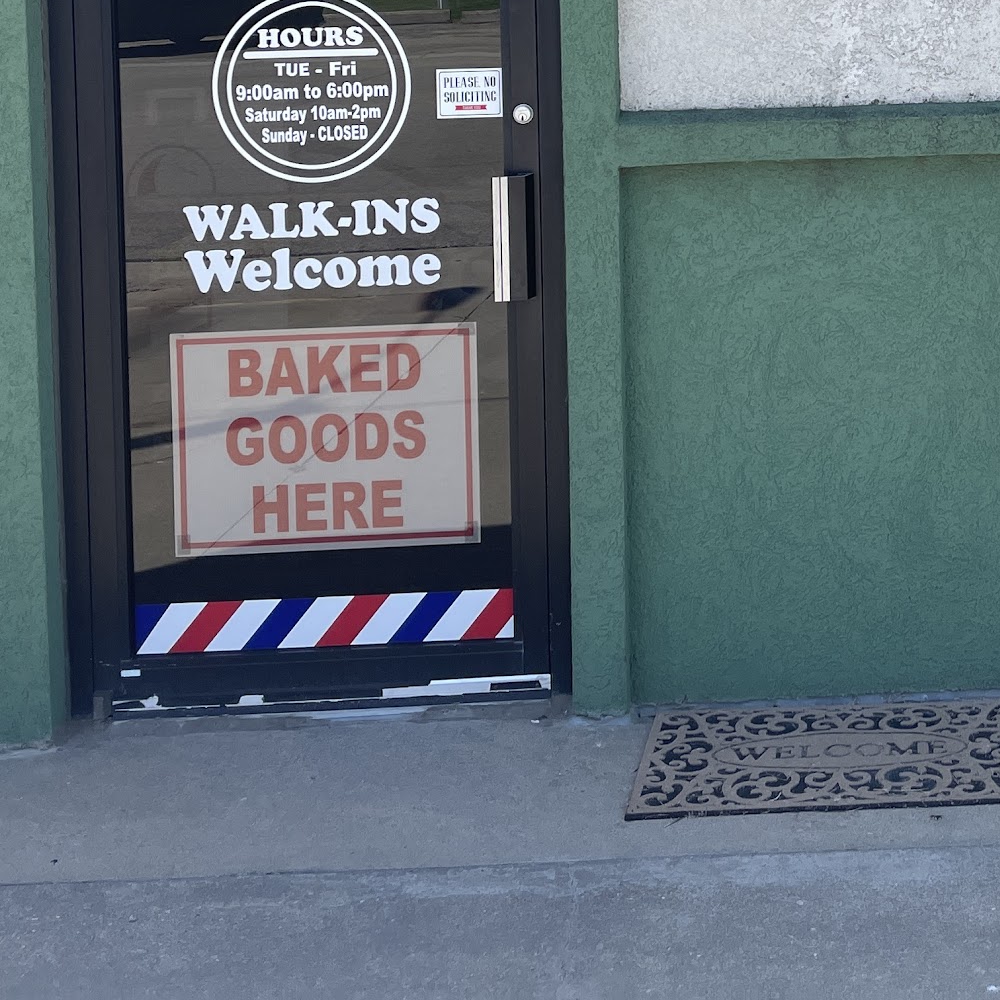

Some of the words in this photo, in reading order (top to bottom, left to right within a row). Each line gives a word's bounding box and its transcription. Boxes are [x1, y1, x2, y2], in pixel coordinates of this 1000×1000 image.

[257, 26, 364, 49] HOURS
[274, 62, 310, 77] TUE
[329, 61, 357, 76] Fri
[235, 84, 299, 101] 9:00am
[303, 83, 322, 99] to
[326, 82, 389, 101] 6:00pm
[443, 76, 481, 89] PLEASE
[484, 75, 496, 88] NO
[443, 90, 497, 103] SOLICITING
[245, 106, 307, 124] Saturday
[311, 104, 381, 122] 10am-2pm
[261, 127, 308, 146] Sunday
[318, 125, 368, 142] CLOSED
[183, 197, 441, 242] WALK-INS
[184, 248, 442, 293] Welcome
[227, 343, 421, 397] BAKED
[226, 410, 427, 466] GOODS
[252, 479, 404, 533] HERE
[733, 741, 948, 761] WELCOME
